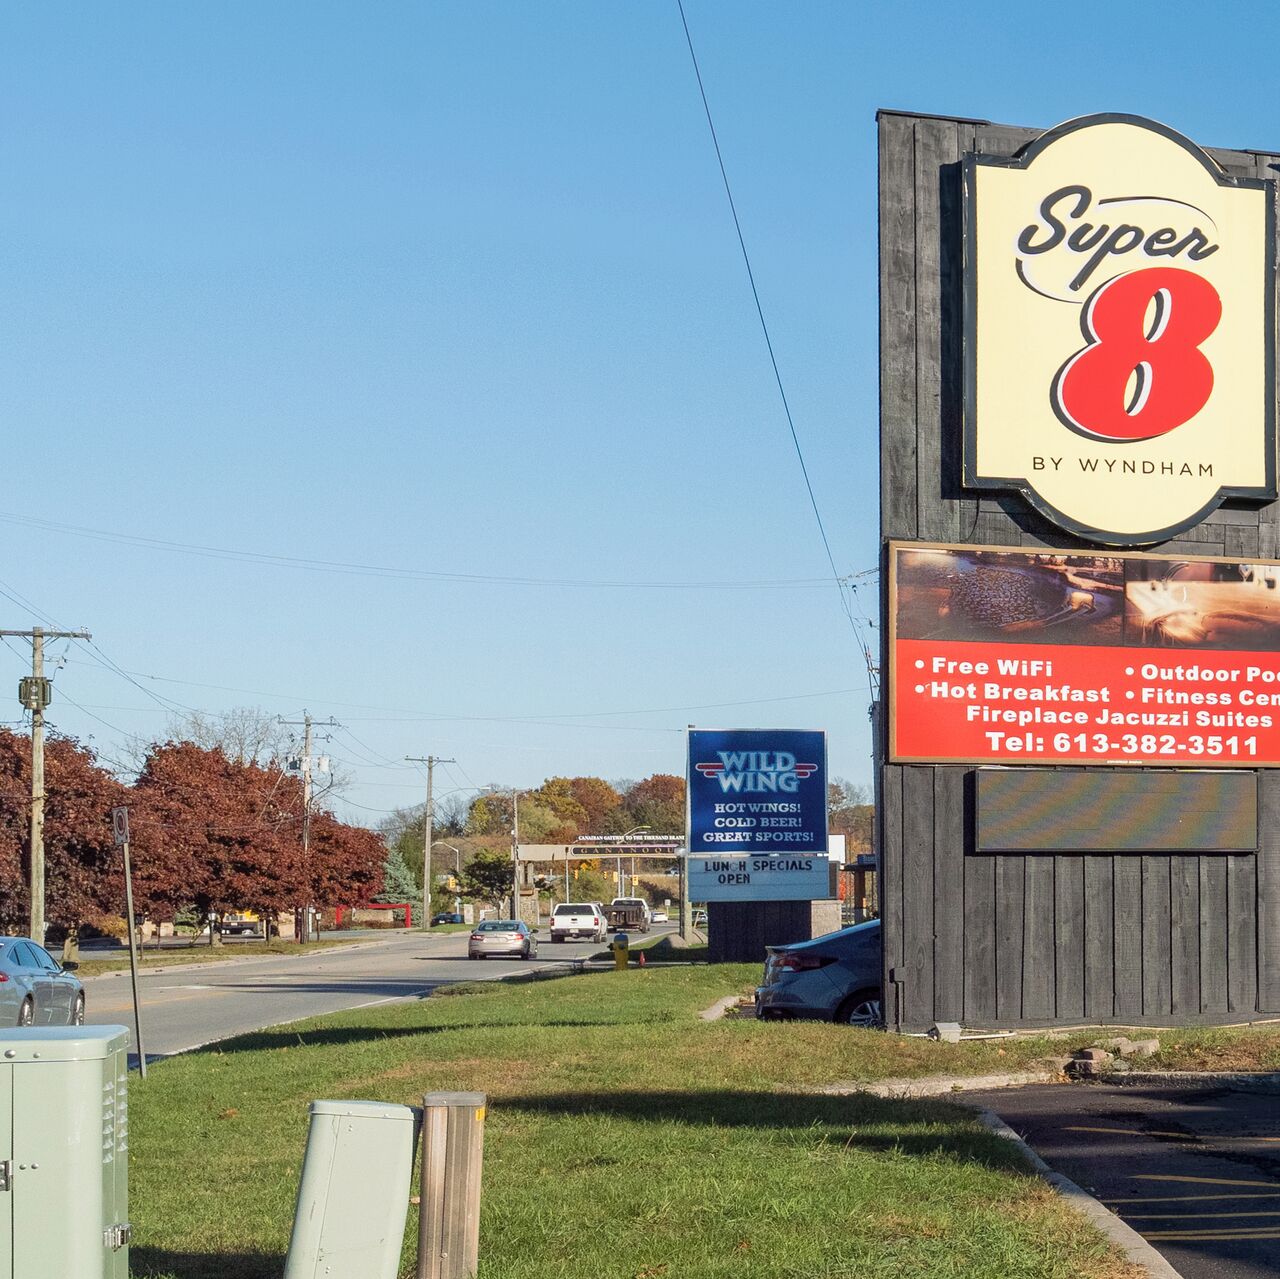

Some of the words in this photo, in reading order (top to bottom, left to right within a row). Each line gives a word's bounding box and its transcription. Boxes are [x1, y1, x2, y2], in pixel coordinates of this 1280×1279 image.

[1017, 184, 1219, 292] Super
[1049, 267, 1222, 444] 8
[1032, 456, 1063, 471] BY
[1079, 458, 1214, 477] WYNDHAM
[932, 657, 990, 675] Free
[997, 659, 1053, 677] WiFi
[1141, 664, 1240, 681] Outdoor
[931, 681, 977, 698] Hot
[984, 683, 1110, 702] Breakfast
[1141, 688, 1232, 705] Fitness
[966, 705, 1089, 726] Fireplace
[1095, 708, 1189, 726] Jacuzzi
[1195, 711, 1273, 727] Suites
[985, 731, 1044, 752] Tel:
[1053, 732, 1257, 755] 613-382-3511
[717, 750, 796, 771] WILD
[717, 771, 800, 793] WING
[714, 803, 746, 813] HOT
[747, 803, 801, 813] WINGS!
[714, 817, 757, 828] COLD
[760, 817, 802, 827] BEER!
[703, 832, 752, 842] GREAT
[755, 831, 814, 842] SPORTS!
[704, 861, 746, 872] LUNCH
[753, 860, 813, 871] SPECIALS
[717, 873, 750, 884] OPEN
